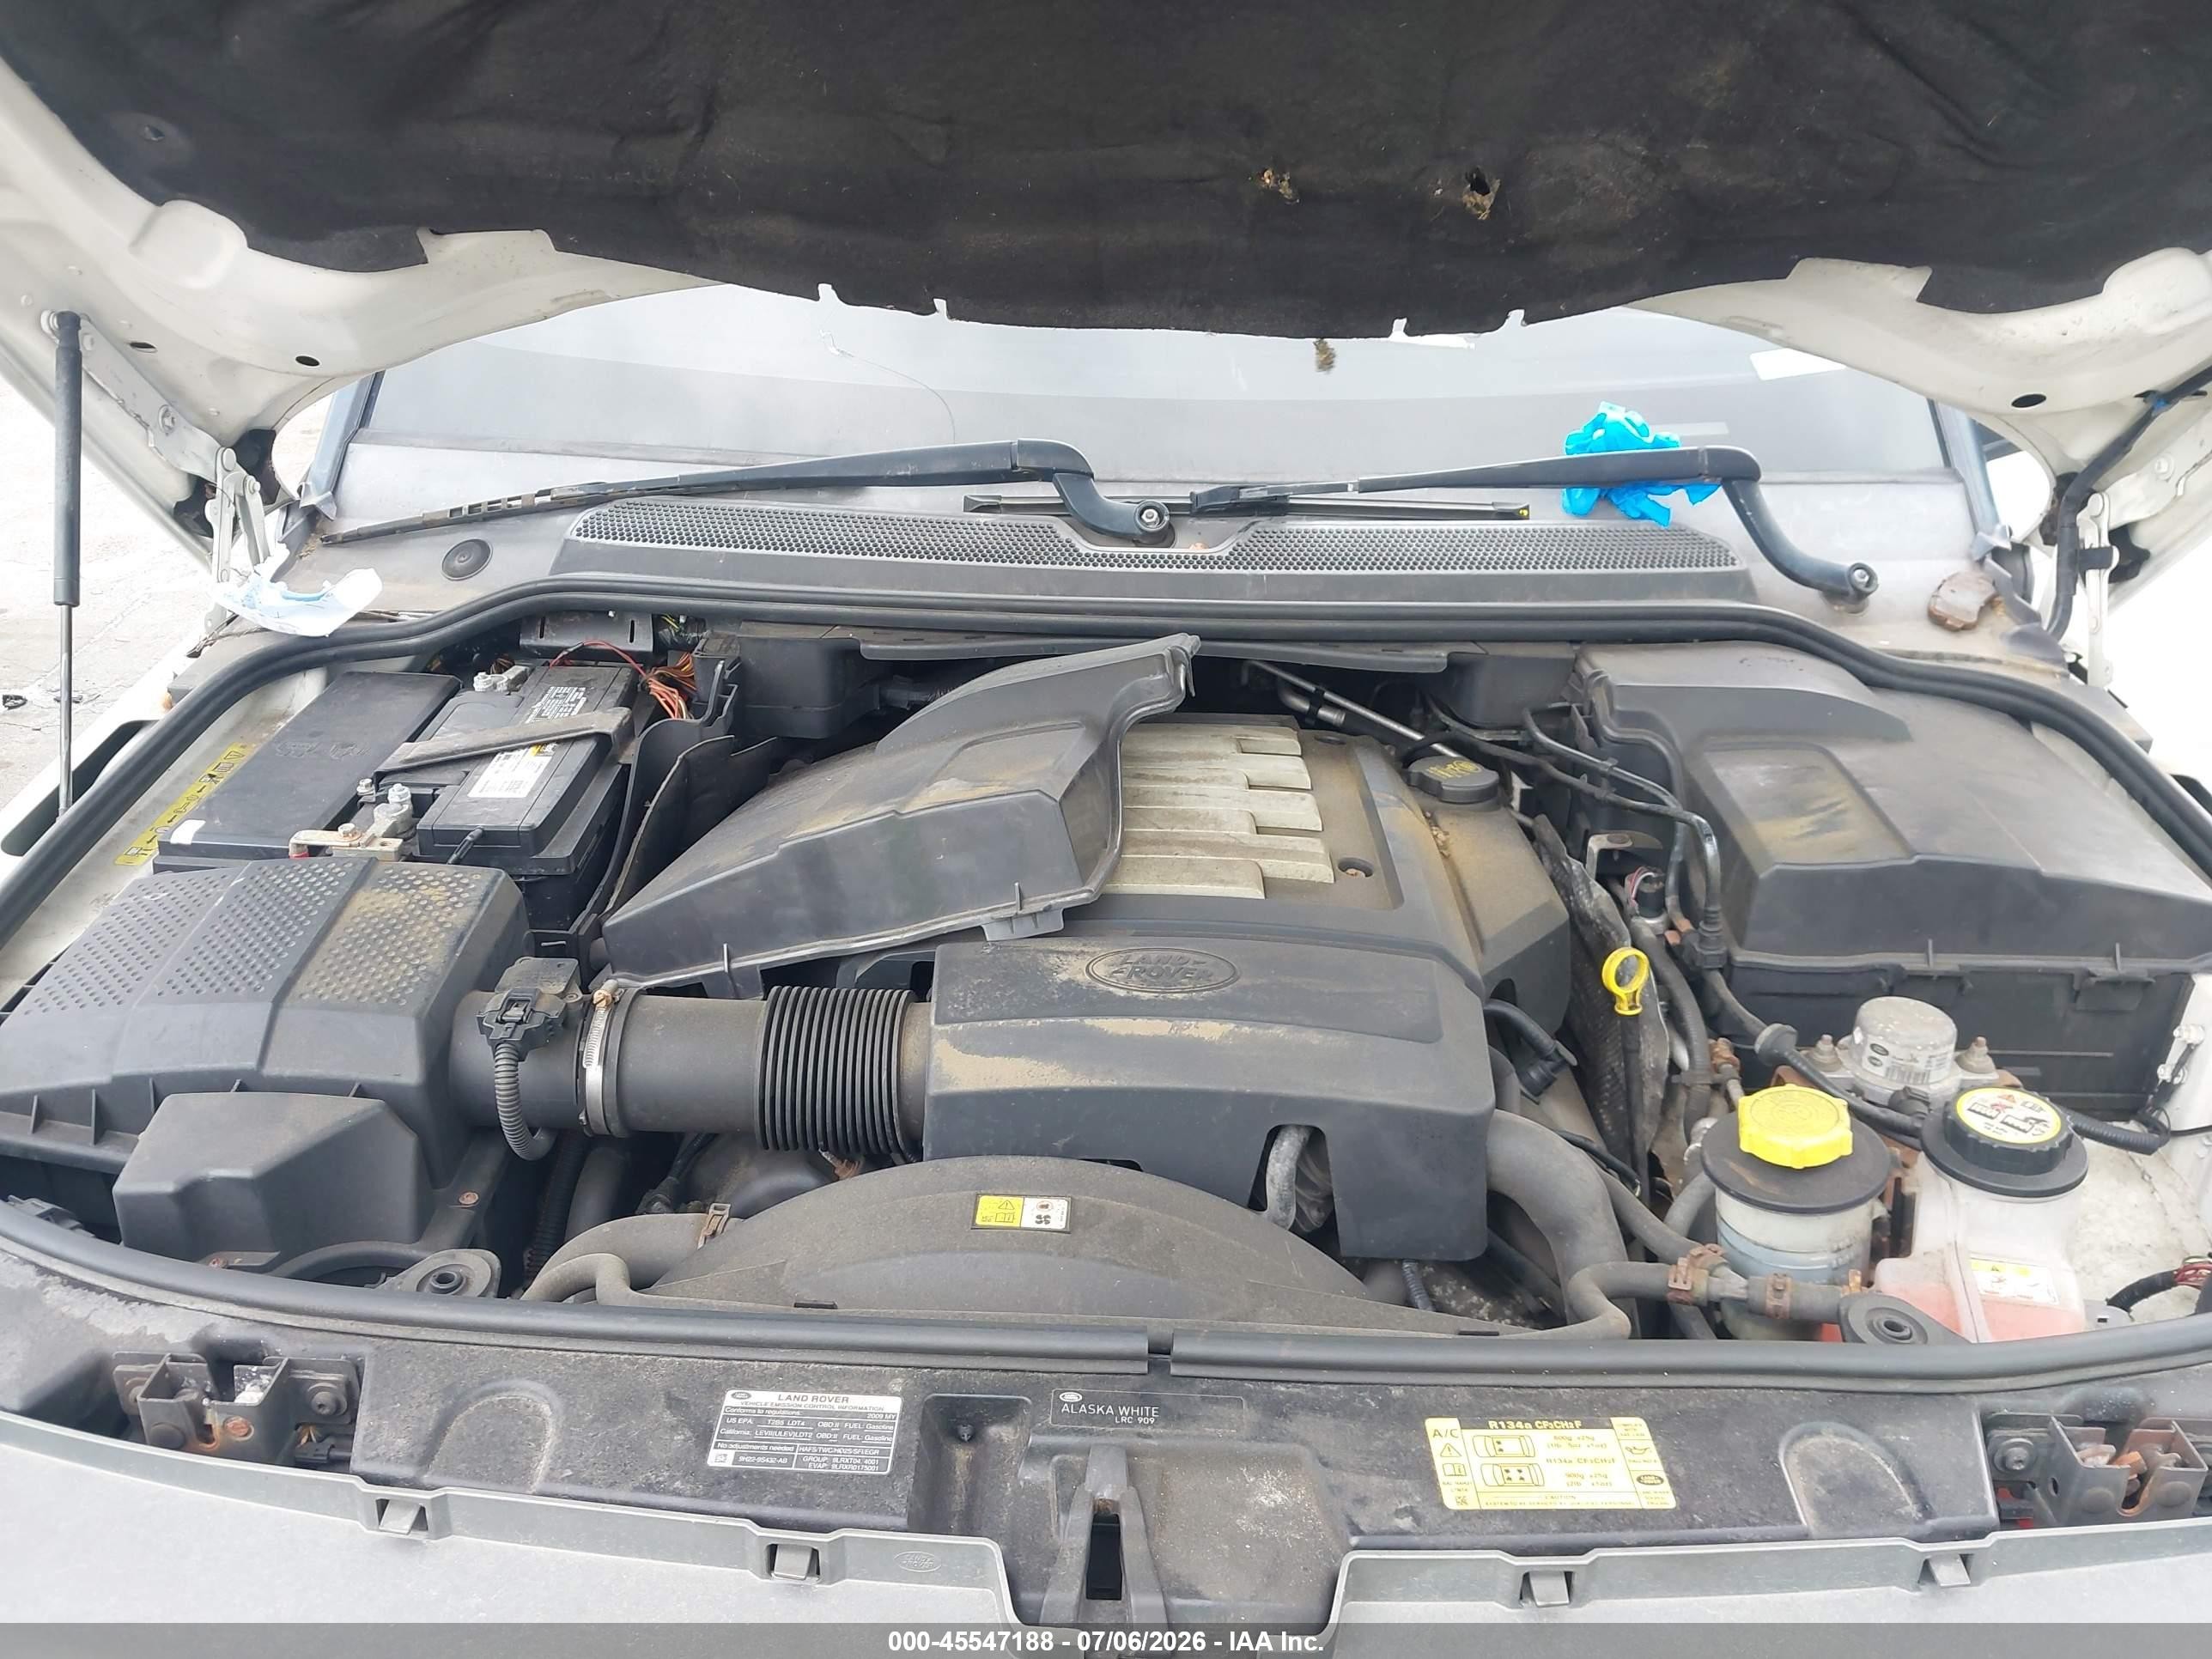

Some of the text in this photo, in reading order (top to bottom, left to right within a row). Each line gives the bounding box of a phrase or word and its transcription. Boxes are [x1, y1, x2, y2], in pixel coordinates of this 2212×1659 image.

[1118, 953, 1193, 966] LAND
[778, 1394, 809, 1402] LAND
[1061, 1403, 1160, 1418] ALASKA WHITE
[1488, 1420, 1532, 1430] R134a
[1432, 1428, 1459, 1438] A/C
[728, 1443, 769, 1451] adjustments
